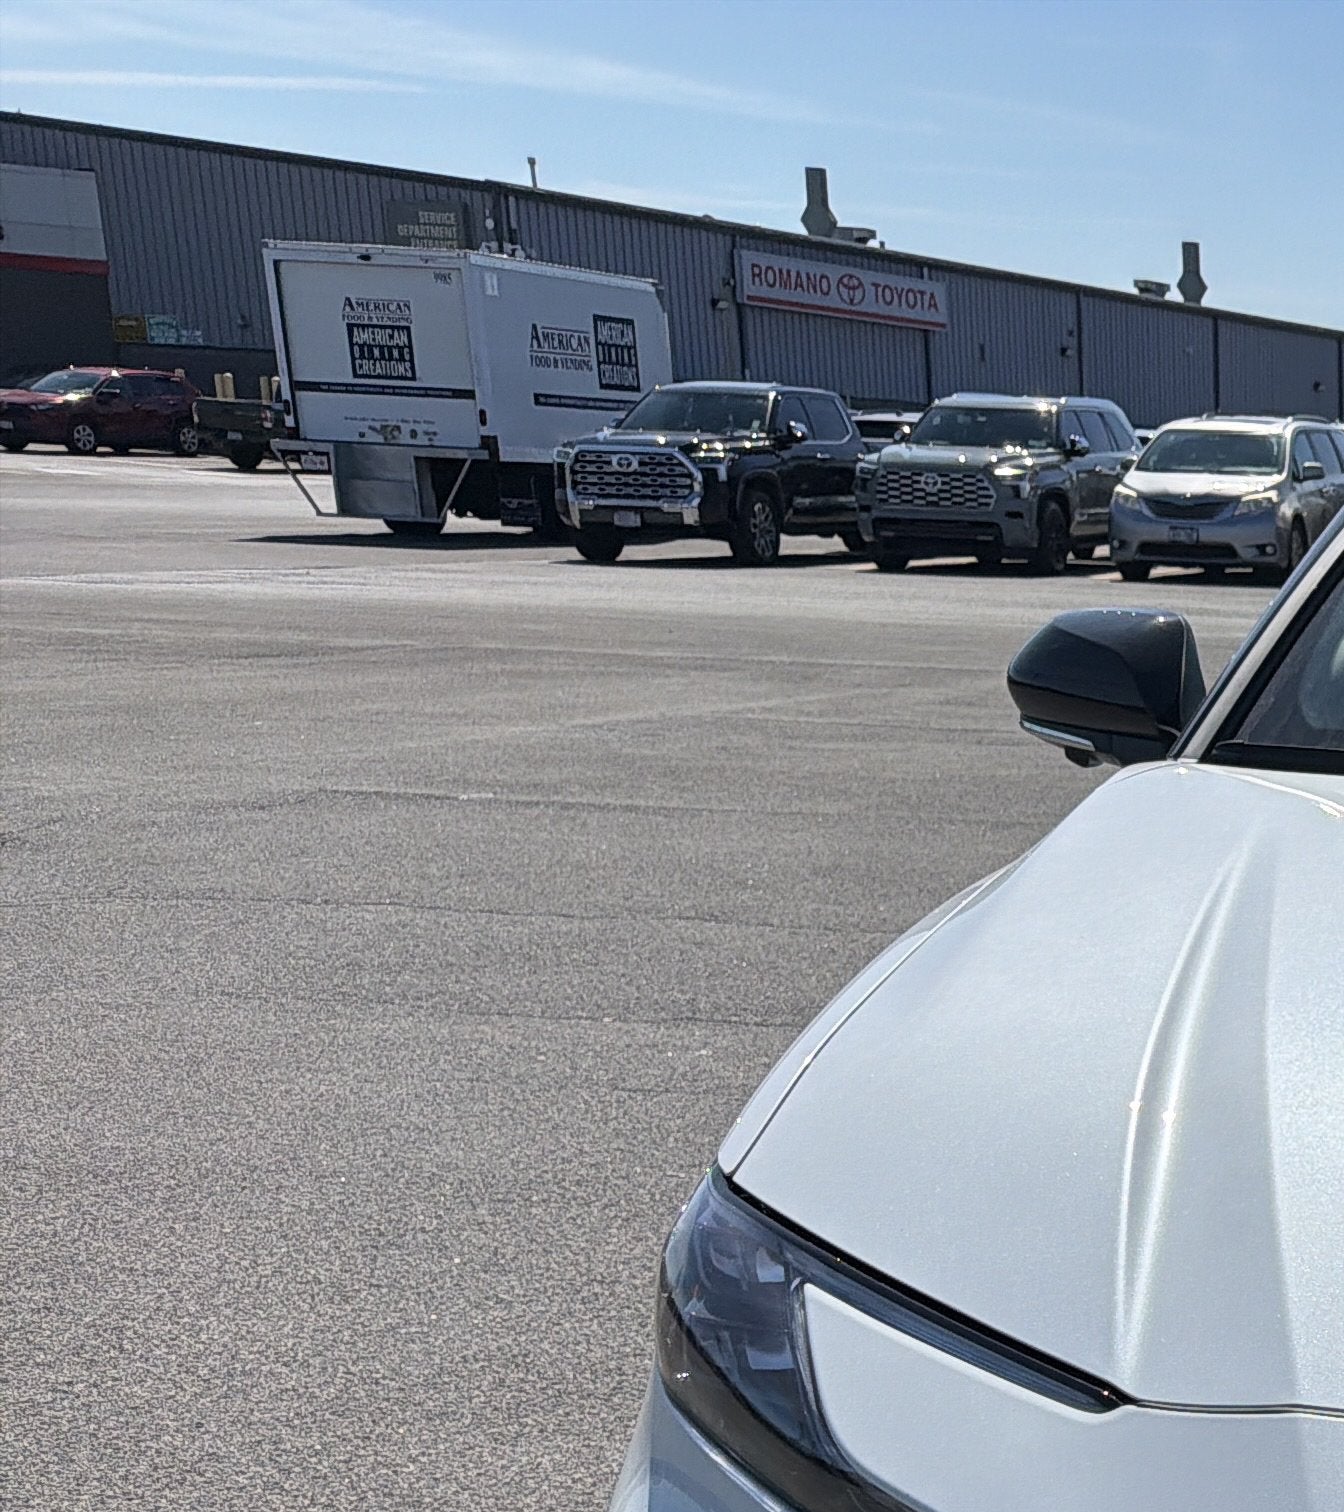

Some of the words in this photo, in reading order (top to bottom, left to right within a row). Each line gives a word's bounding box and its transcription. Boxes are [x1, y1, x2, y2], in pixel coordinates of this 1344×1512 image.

[418, 211, 456, 224] SERVICE
[397, 224, 457, 239] DEPARTMENT
[751, 263, 831, 296] ROMANO
[871, 282, 940, 313] TOYOTA
[342, 296, 411, 313] AMERICAN
[353, 326, 409, 347] AMERICAN
[530, 323, 591, 353] AMERICAN
[354, 345, 410, 360] DINING
[355, 359, 413, 378] CREATIONS
